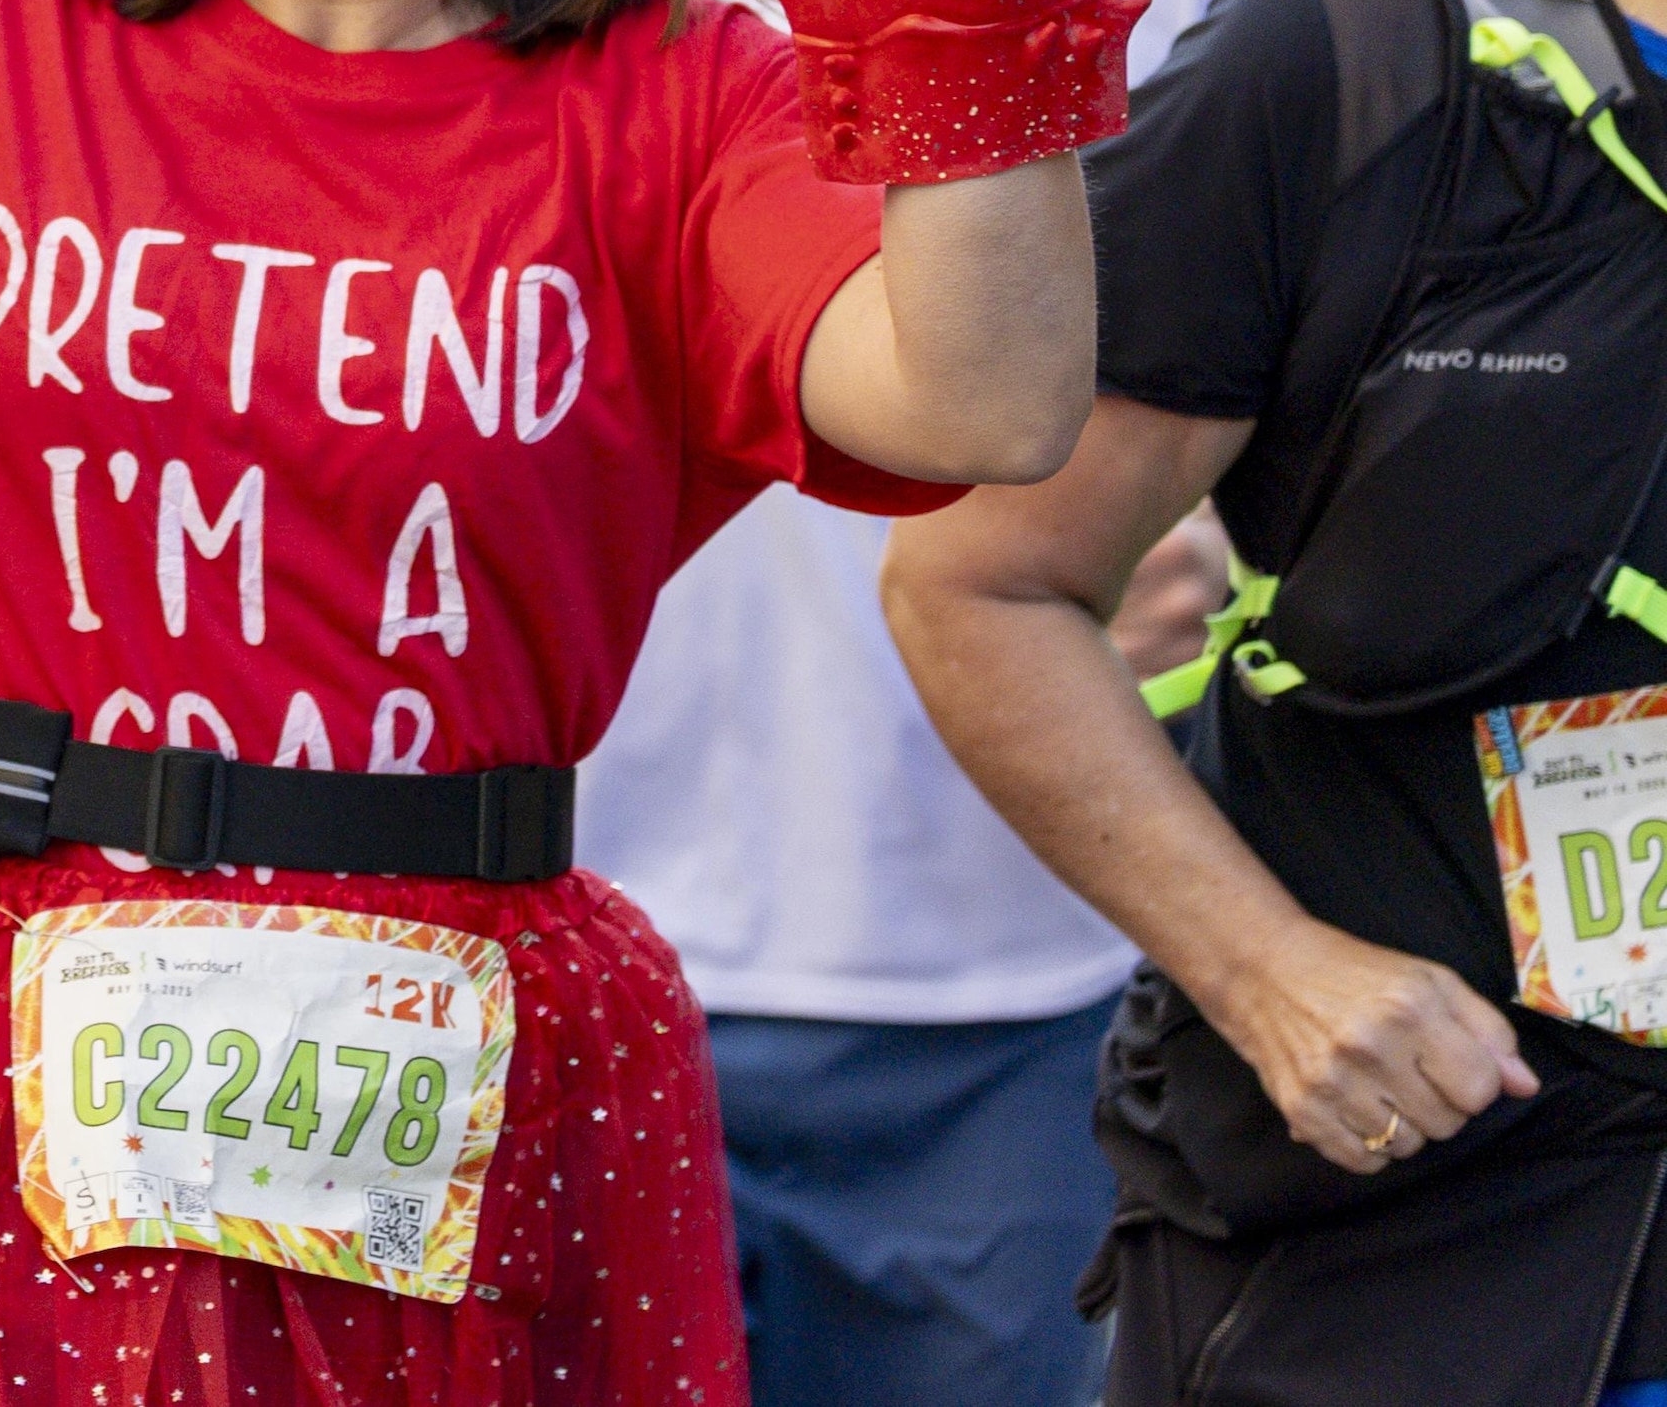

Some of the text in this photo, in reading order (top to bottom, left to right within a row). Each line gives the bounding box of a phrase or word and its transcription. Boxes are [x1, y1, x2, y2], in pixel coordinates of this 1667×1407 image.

[1403, 348, 1567, 374] NEVO RHINO
[42, 446, 468, 657] I'M A
[173, 958, 243, 975] windsurf
[364, 972, 457, 1029] 12K
[72, 1021, 448, 1167] C22478
